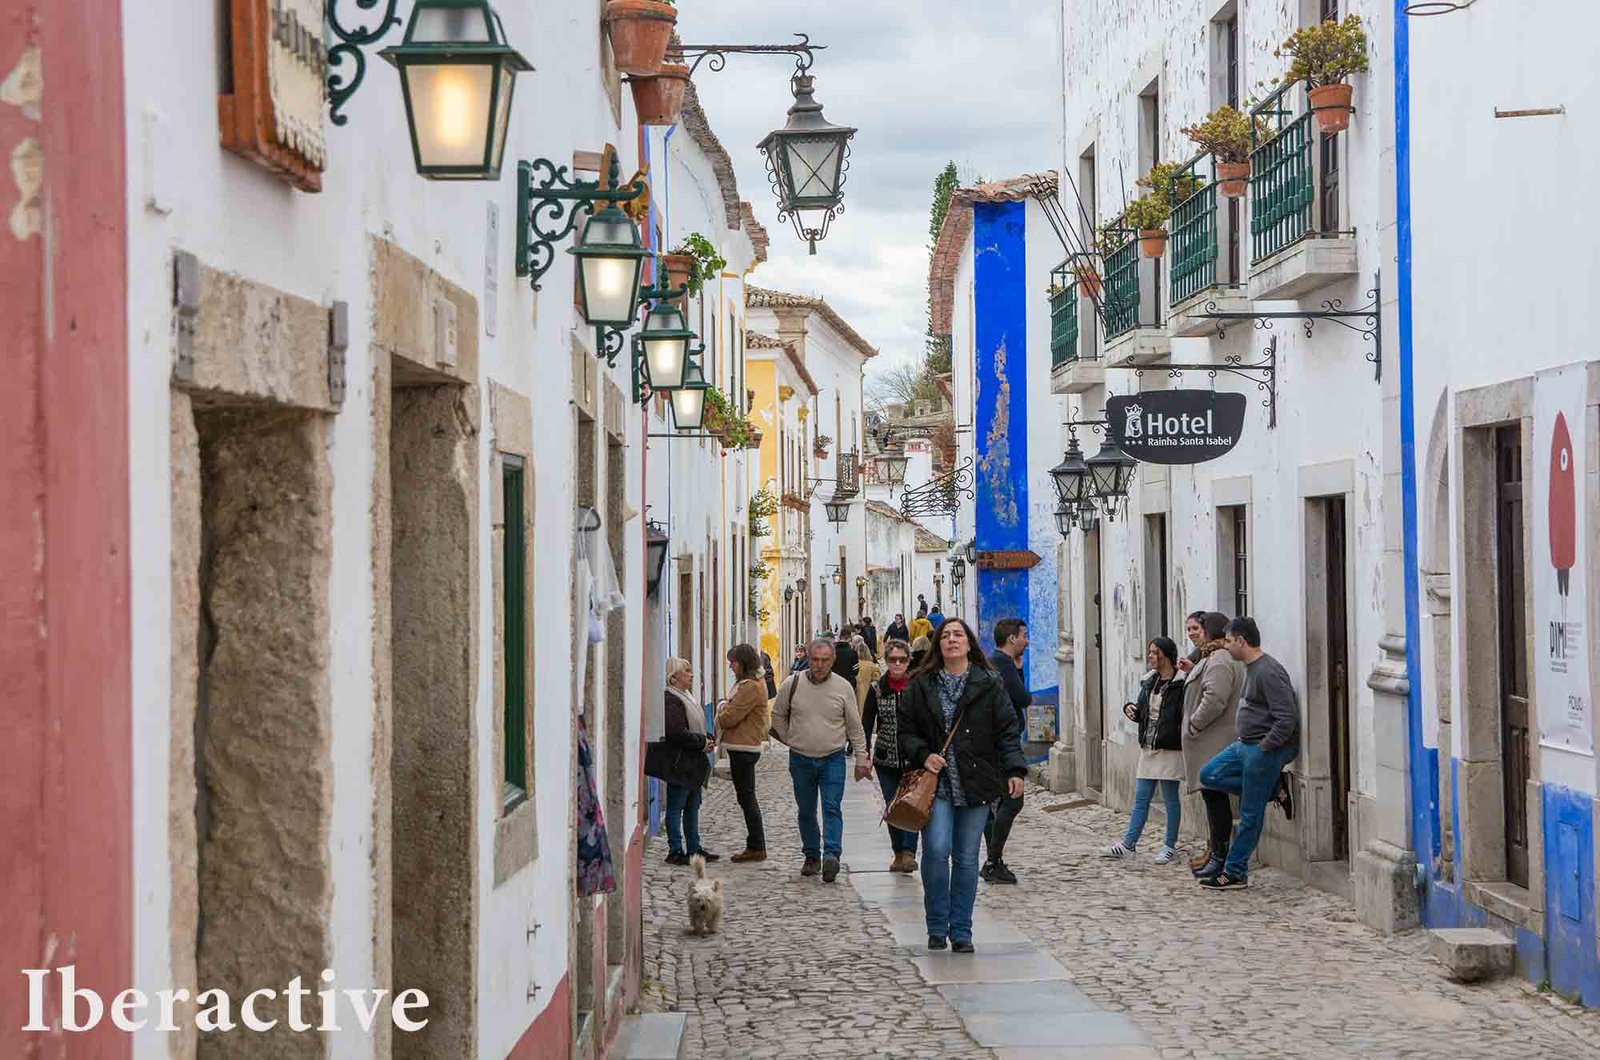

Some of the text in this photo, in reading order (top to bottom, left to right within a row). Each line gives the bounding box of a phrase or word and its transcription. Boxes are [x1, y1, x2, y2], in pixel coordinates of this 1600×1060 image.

[1147, 409, 1212, 435] Hotel
[1148, 436, 1232, 446] Rainha Santa Isabel
